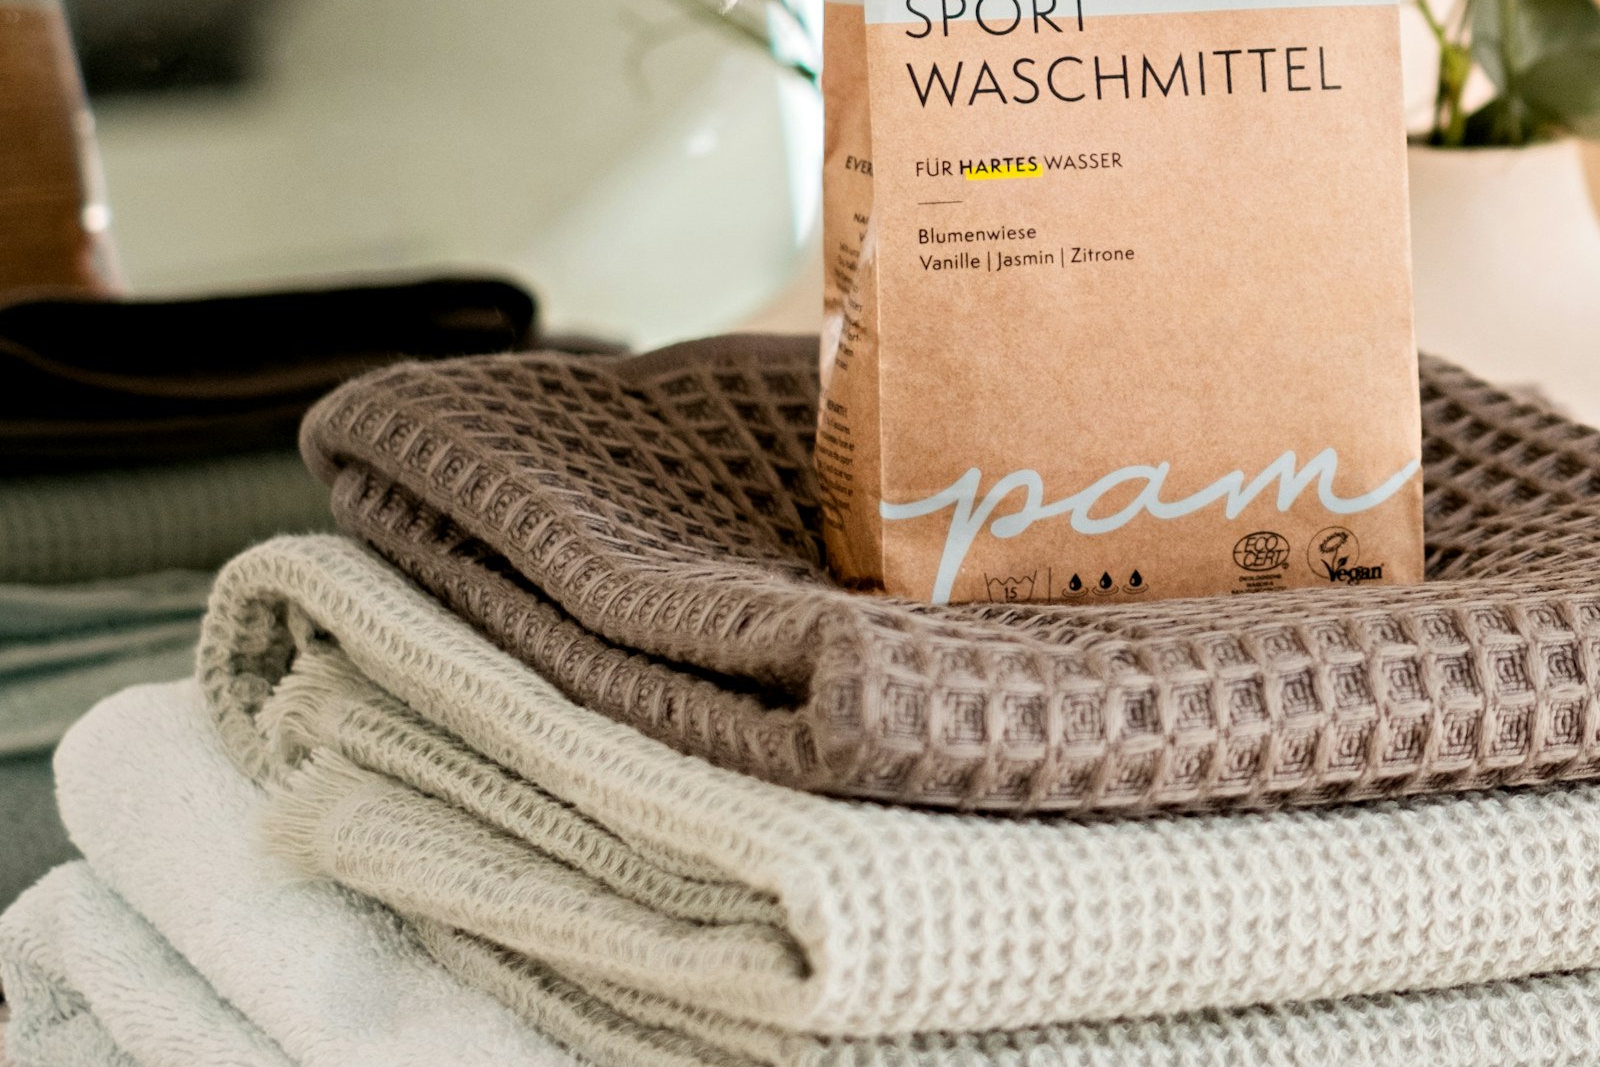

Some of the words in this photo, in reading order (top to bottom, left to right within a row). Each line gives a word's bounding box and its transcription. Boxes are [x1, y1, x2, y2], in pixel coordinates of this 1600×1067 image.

[905, 46, 1342, 108] WASCHMITTEL
[915, 158, 954, 178] FÜR
[959, 156, 1038, 175] HARTES
[1043, 152, 1123, 171] WASSER
[918, 226, 1037, 245] Blumenwiese
[919, 252, 981, 271] Vanille
[996, 250, 1054, 271] Jasmin
[1070, 247, 1135, 264] Zitrone
[880, 447, 1420, 604] pam
[1244, 535, 1279, 553] ECO
[1243, 549, 1285, 567] CERT
